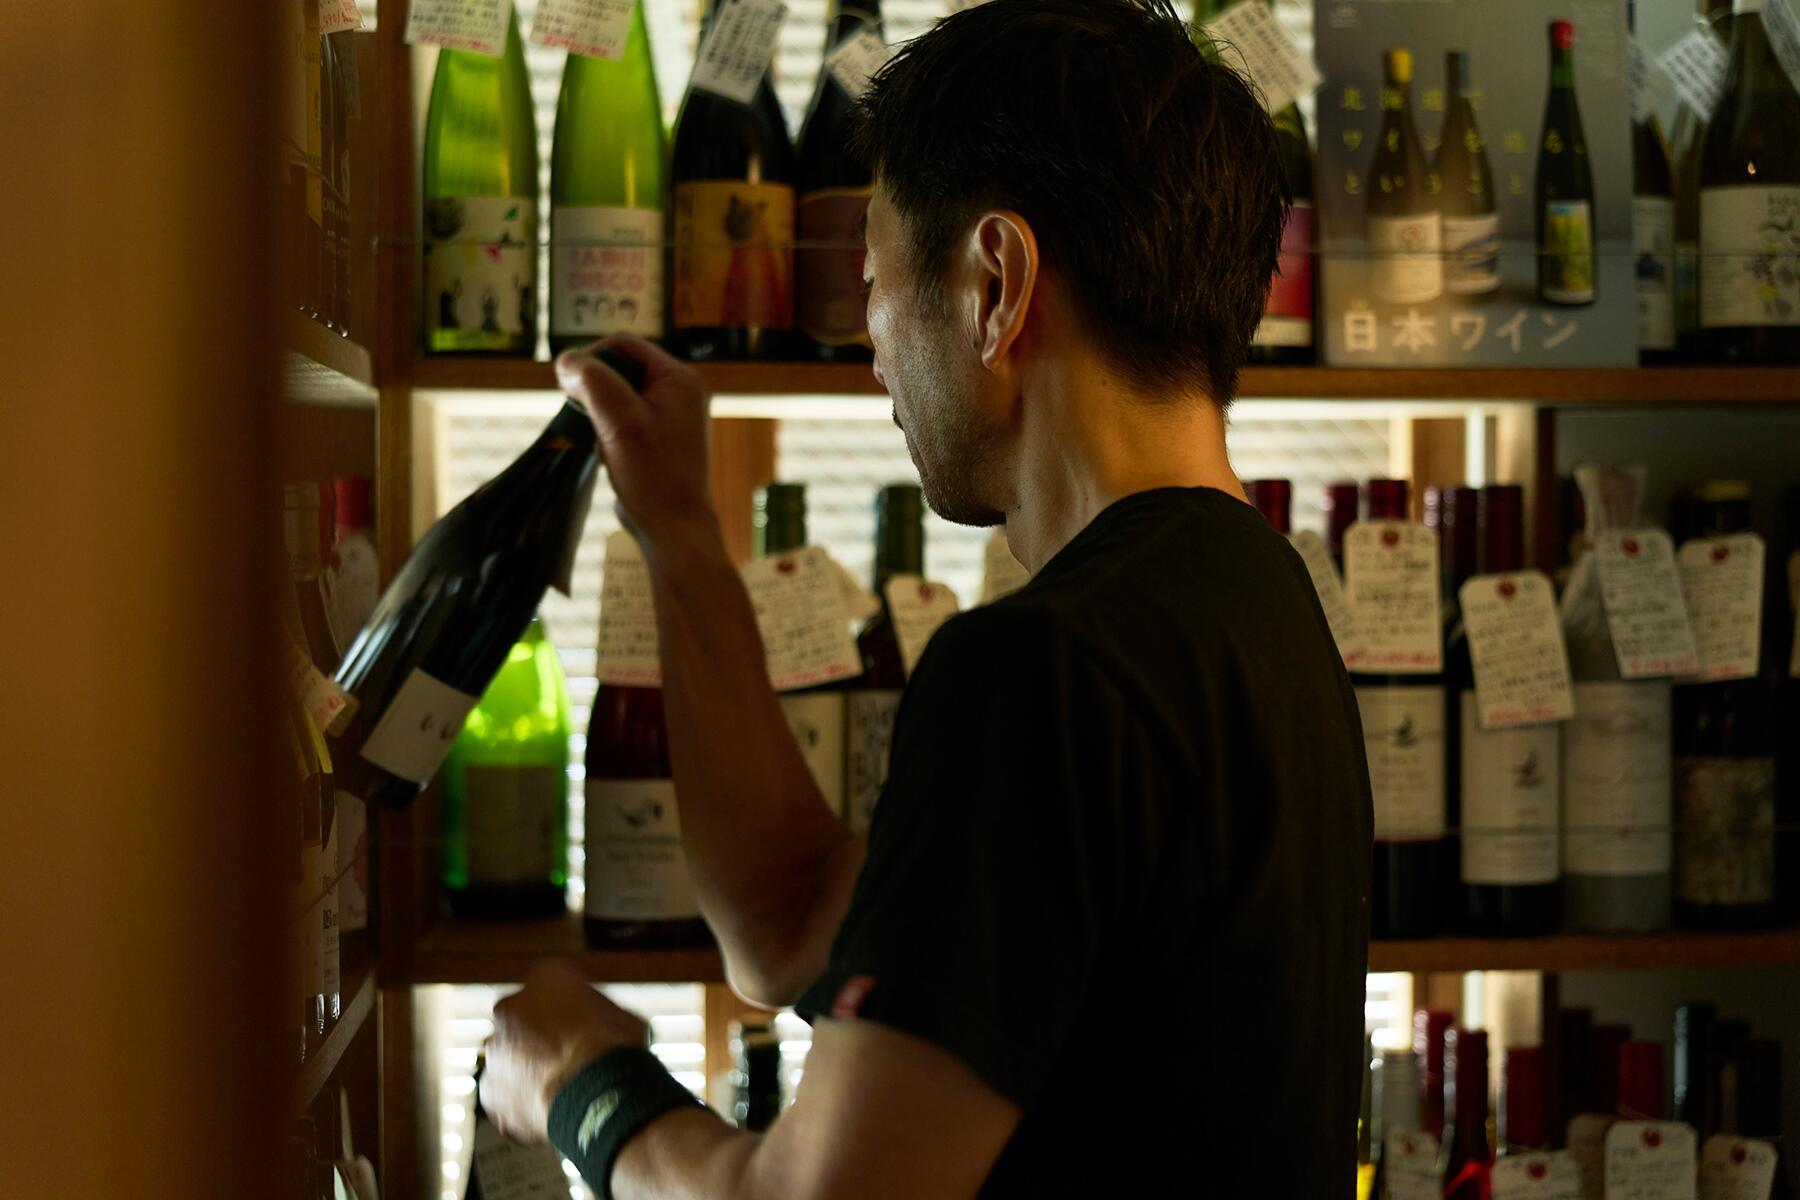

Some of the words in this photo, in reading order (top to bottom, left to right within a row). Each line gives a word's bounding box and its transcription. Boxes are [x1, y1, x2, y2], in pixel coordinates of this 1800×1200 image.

[1343, 308, 1580, 353] 日本ワイン
